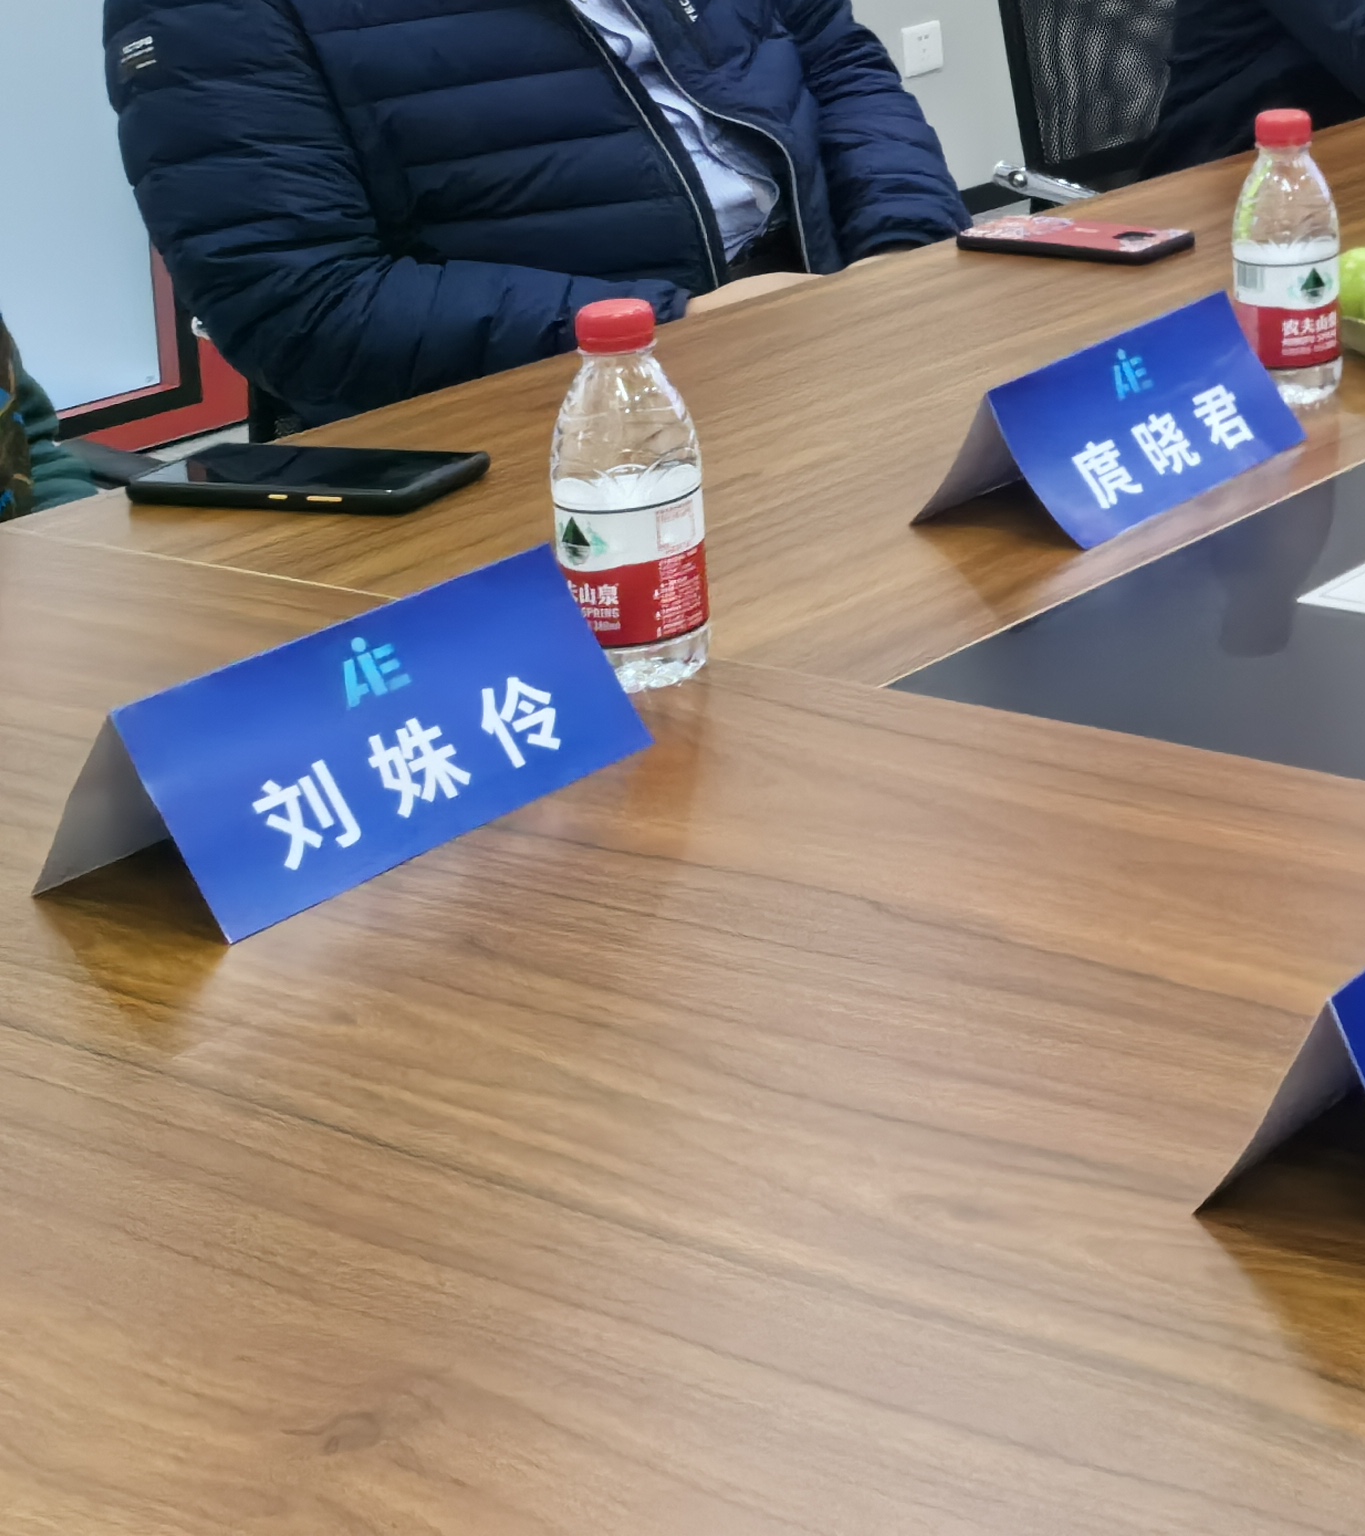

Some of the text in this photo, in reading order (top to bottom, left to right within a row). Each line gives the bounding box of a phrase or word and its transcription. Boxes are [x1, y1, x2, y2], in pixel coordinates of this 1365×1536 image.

[1070, 383, 1256, 510] 庹晓君
[251, 674, 562, 872] 刘姝伶
